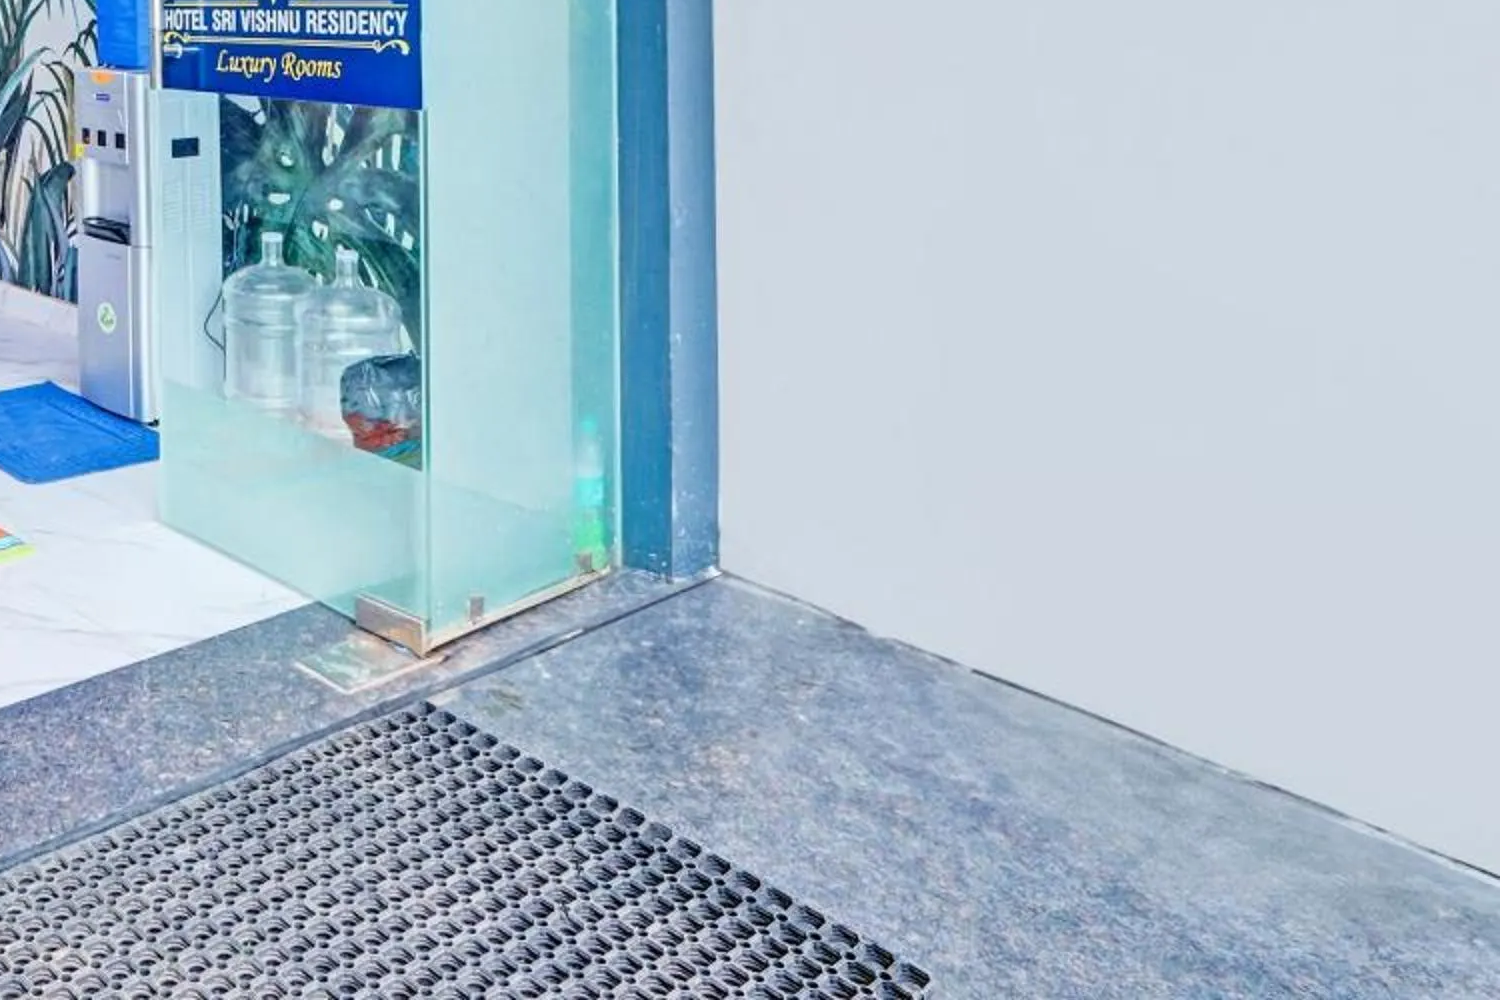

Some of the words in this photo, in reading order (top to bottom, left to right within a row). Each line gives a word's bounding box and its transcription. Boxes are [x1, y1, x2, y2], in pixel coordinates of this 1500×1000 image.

[164, 8, 208, 31] HOTEL
[212, 9, 237, 32] SRI
[240, 9, 300, 34] VISHNU
[305, 9, 408, 36] RESIDENCY
[216, 49, 277, 83] Luxury
[281, 52, 342, 81] Rooms
